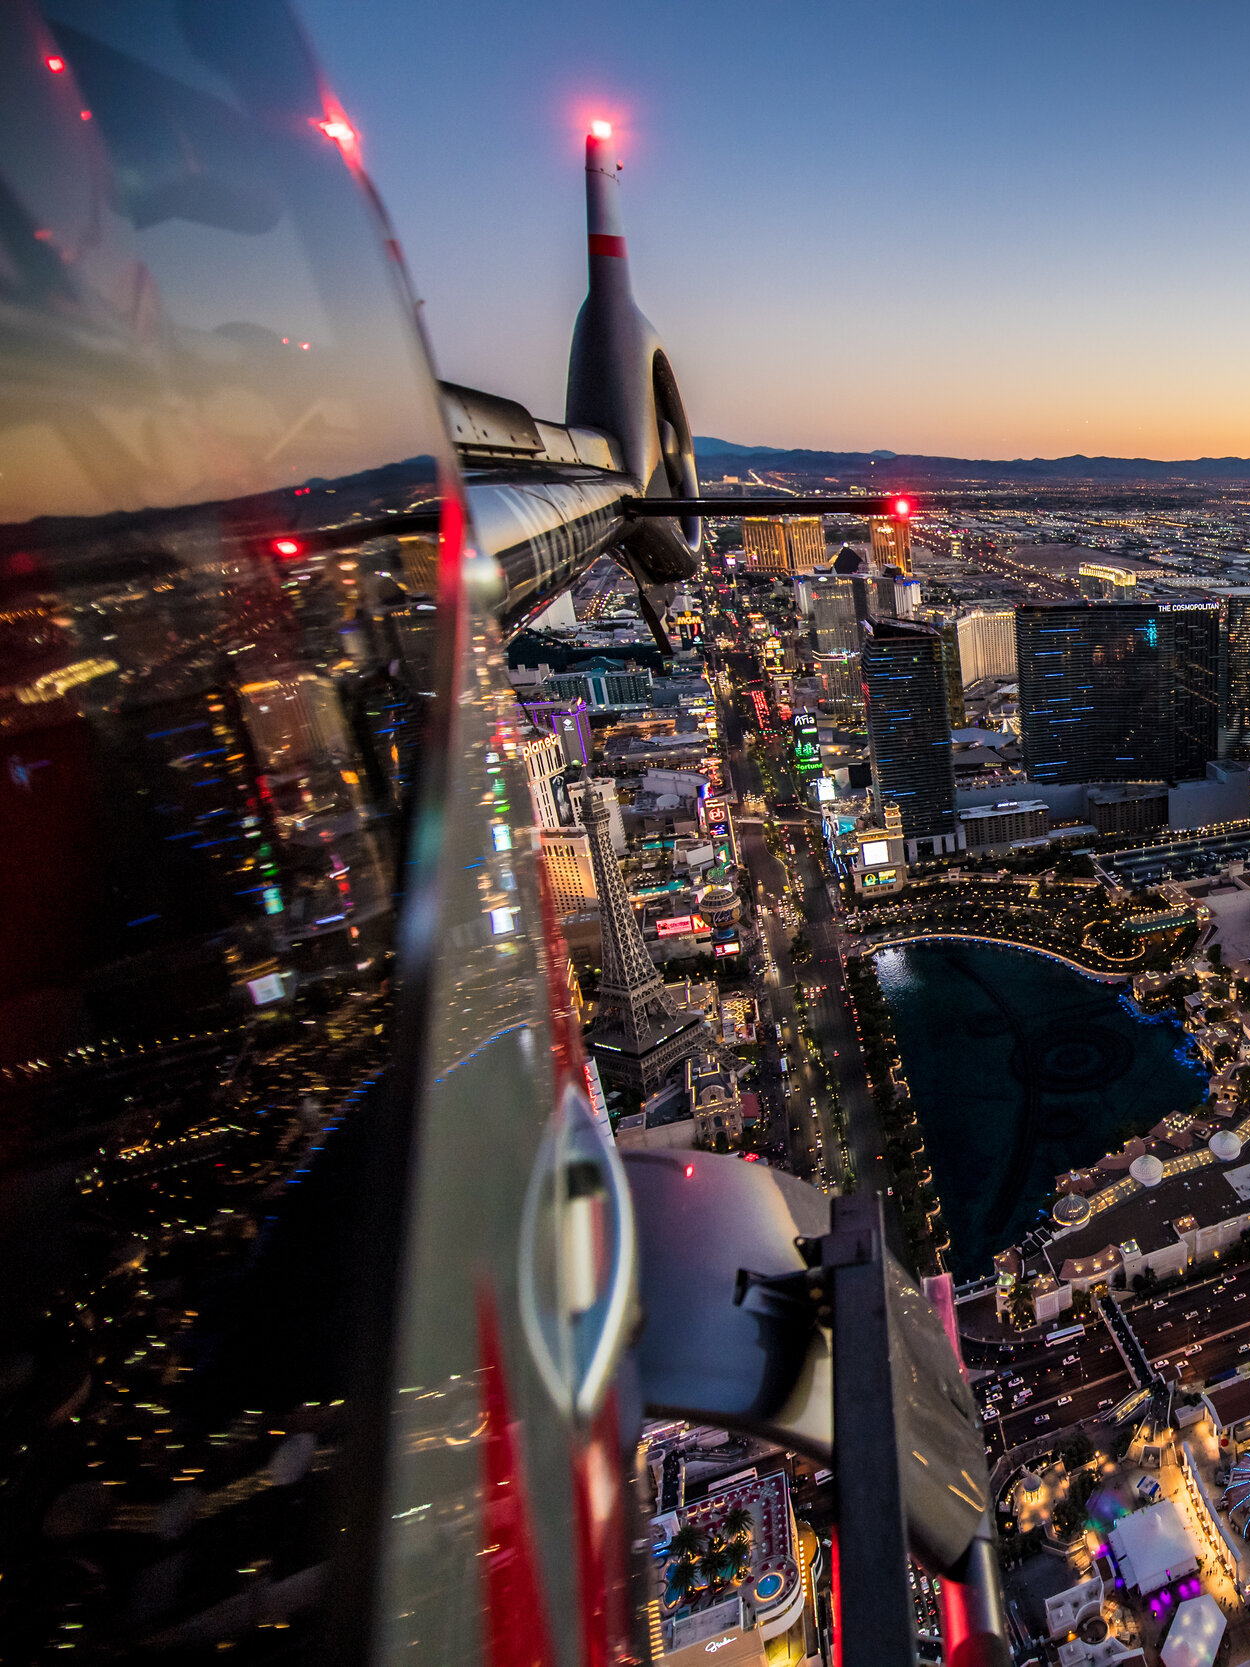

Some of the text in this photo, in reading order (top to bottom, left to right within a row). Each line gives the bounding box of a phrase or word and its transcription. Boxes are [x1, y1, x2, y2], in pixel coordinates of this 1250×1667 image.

[1158, 603, 1219, 612] THE COSMOPOLITAN
[676, 616, 701, 625] MGM
[522, 733, 557, 761] planet
